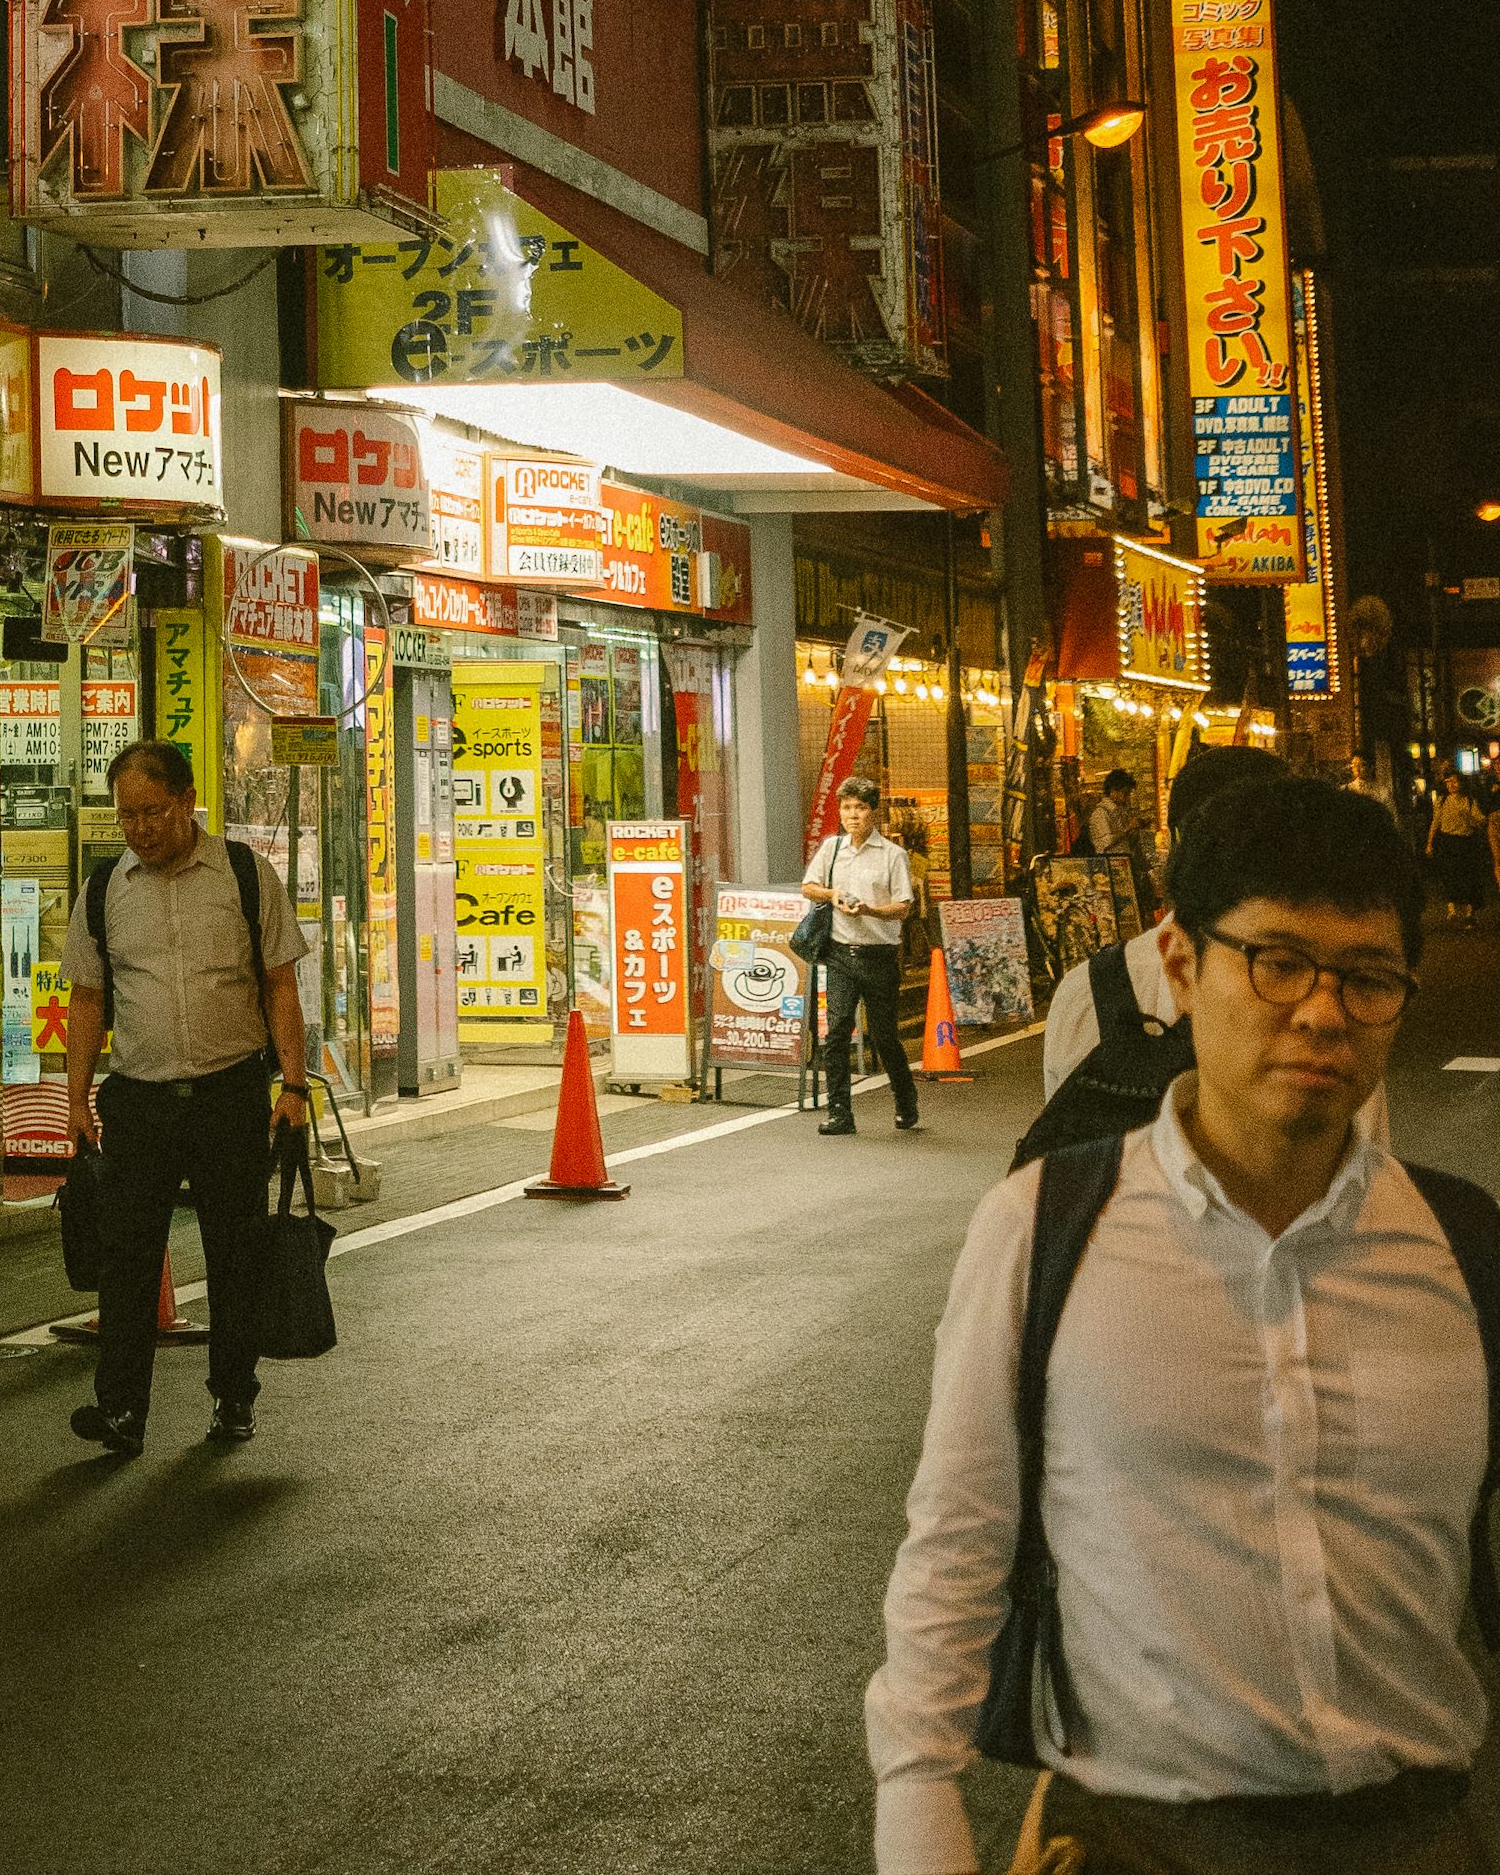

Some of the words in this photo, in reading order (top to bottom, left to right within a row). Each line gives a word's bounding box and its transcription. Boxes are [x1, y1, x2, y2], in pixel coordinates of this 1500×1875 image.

[1182, 26, 1264, 52] 写真集
[411, 289, 500, 336] 2F
[1194, 399, 1216, 414] 3F
[1226, 396, 1281, 414] ADULT
[1196, 439, 1217, 455] 2F
[538, 469, 591, 492] ROCKET
[1208, 465, 1280, 477] PC-GAME
[1209, 495, 1282, 507] TV-GAME
[52, 550, 126, 572] JCB
[1252, 557, 1296, 573] AKIBA
[234, 553, 309, 605] ROCKET
[394, 630, 427, 662] LOCKER
[612, 826, 680, 839] ROCKET
[613, 841, 681, 861] e-café
[651, 875, 677, 1005] eスポーツ
[623, 929, 648, 1028] &カフェ
[3, 1138, 76, 1157] ROCKET
